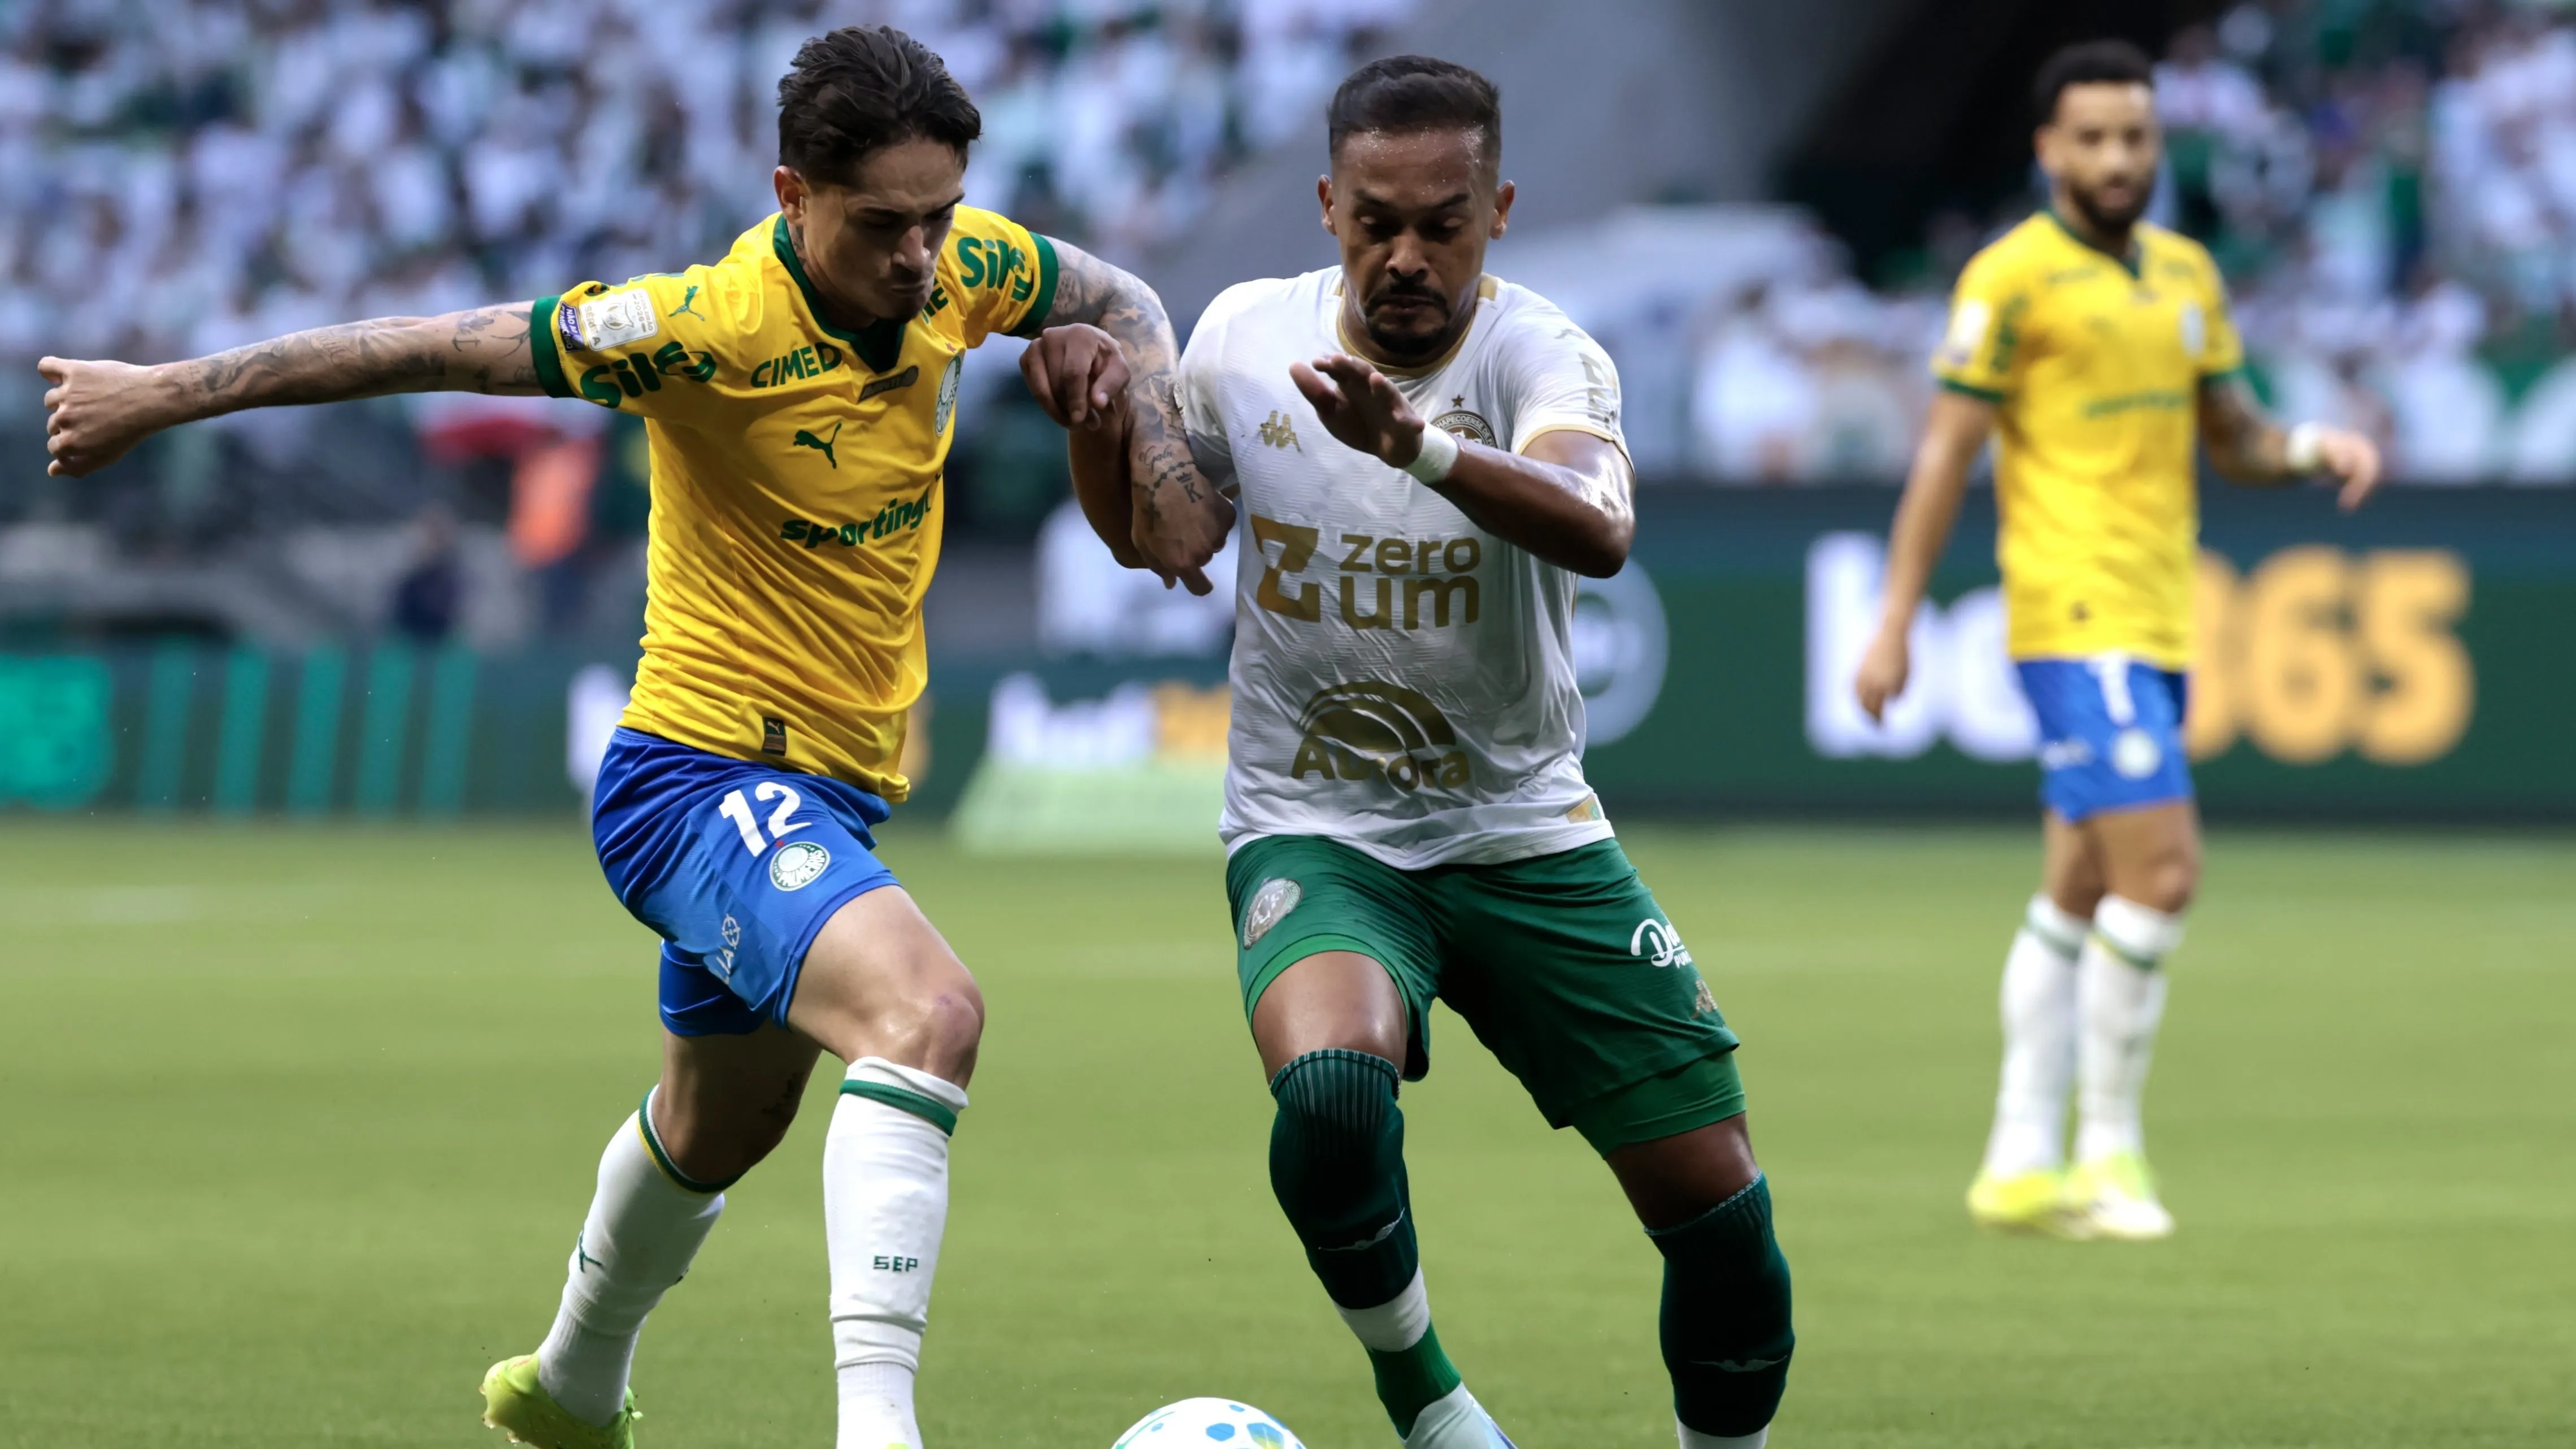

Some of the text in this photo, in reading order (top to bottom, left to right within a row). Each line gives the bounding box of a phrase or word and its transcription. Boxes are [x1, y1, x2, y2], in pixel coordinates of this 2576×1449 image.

[750, 342, 842, 388] CIMED
[1436, 415, 1484, 430] HAPECOENSE
[1184, 481, 1204, 504] K
[1339, 534, 1481, 575] zero
[1340, 575, 1480, 630] um
[719, 782, 812, 857] 12
[873, 1256, 918, 1272] SEP
